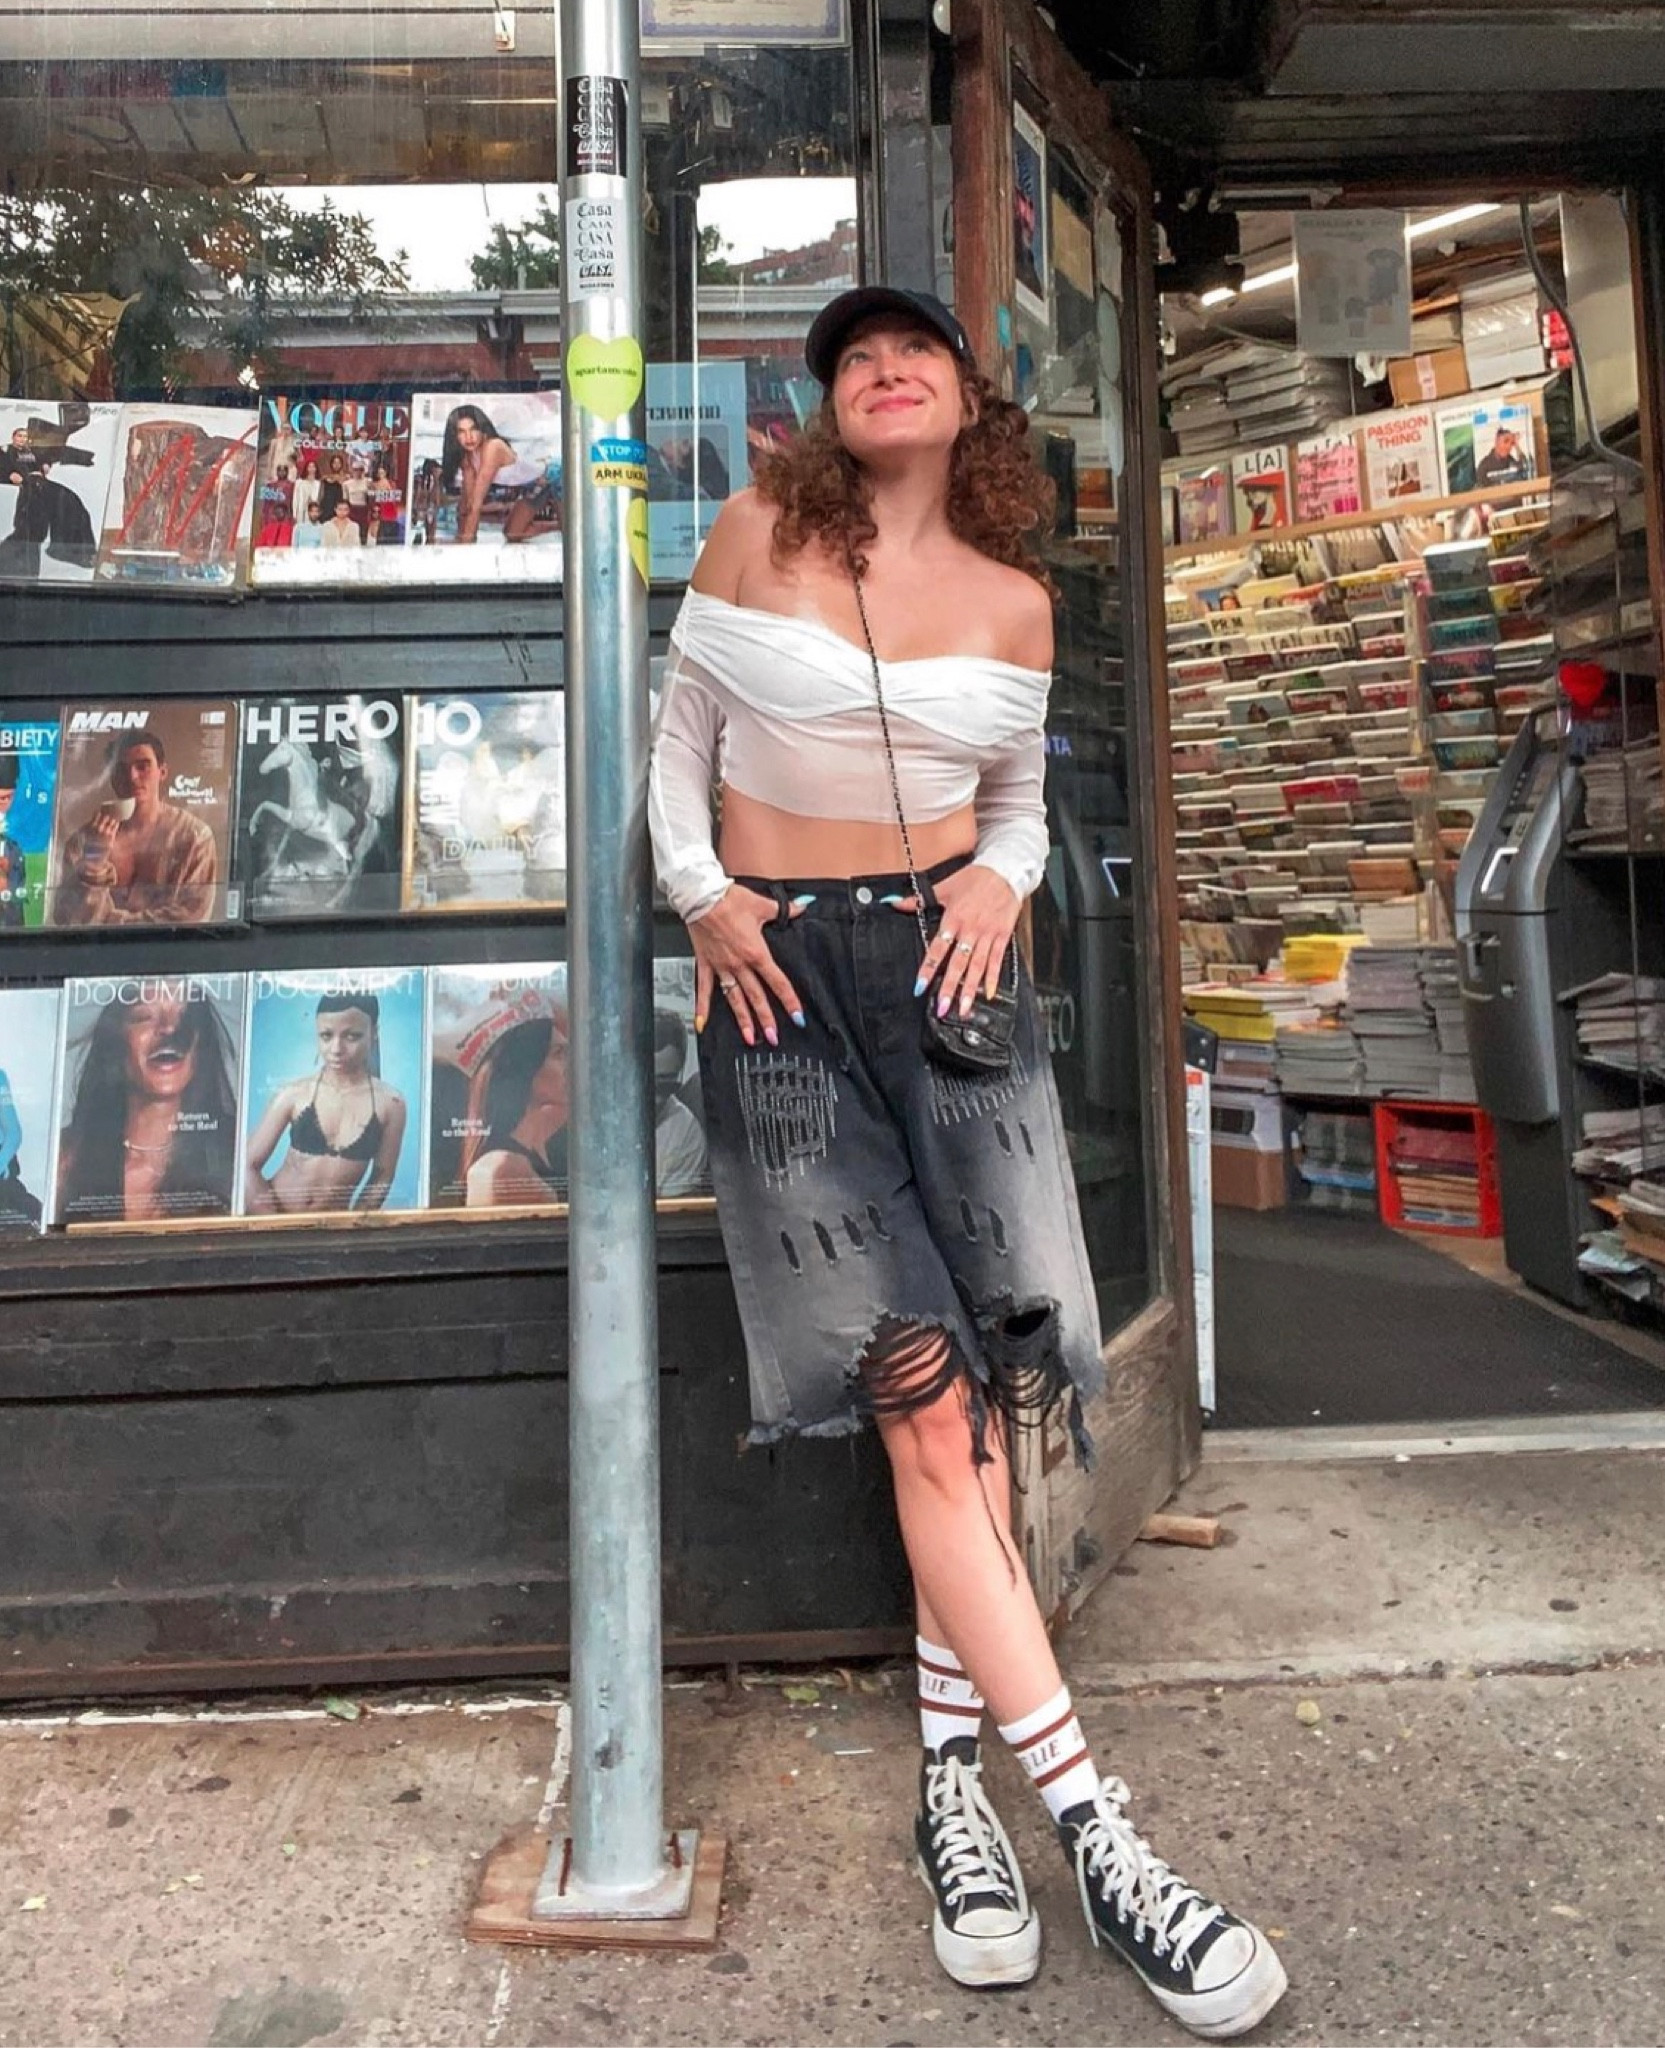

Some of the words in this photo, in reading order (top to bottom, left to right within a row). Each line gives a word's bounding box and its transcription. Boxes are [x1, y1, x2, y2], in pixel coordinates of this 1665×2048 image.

[267, 397, 409, 440] VOGUE
[1366, 414, 1429, 439] PASSION
[1376, 431, 1423, 450] THING
[596, 469, 623, 480] ARM
[69, 710, 150, 730] MAN
[246, 700, 400, 744] HERO
[416, 701, 482, 746] 10
[0, 728, 58, 748] BIETY
[74, 978, 236, 1007] DOCUMENT
[177, 1111, 210, 1122] Return
